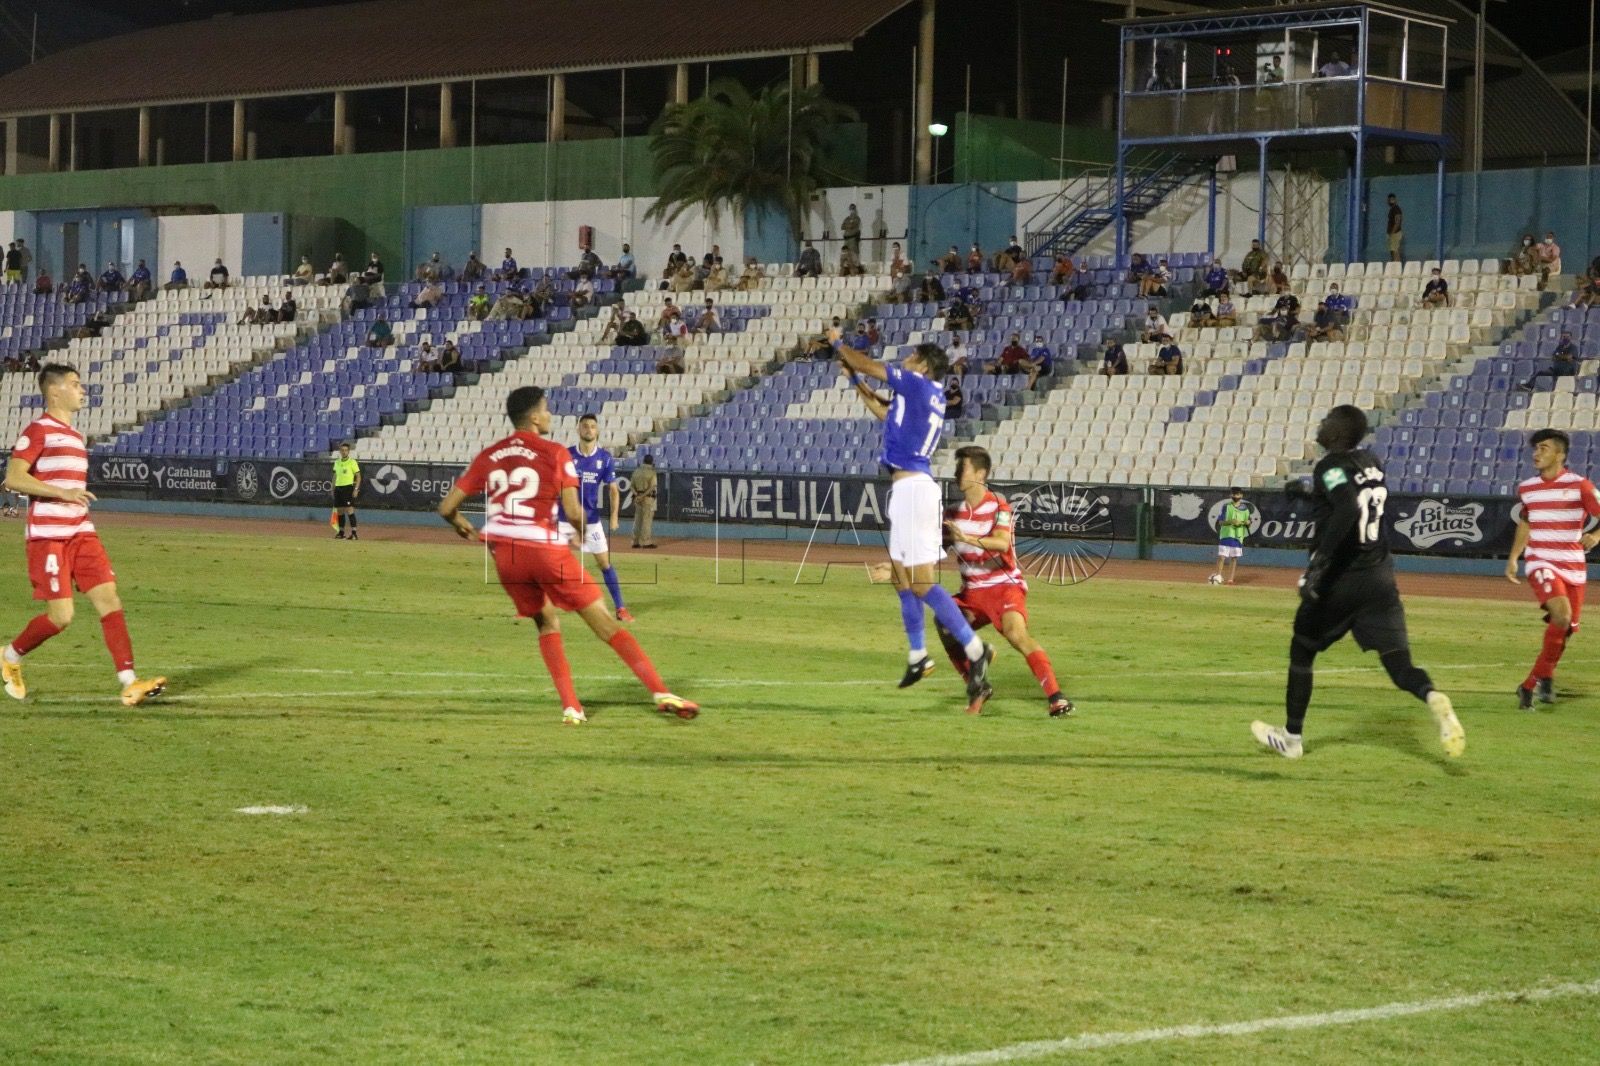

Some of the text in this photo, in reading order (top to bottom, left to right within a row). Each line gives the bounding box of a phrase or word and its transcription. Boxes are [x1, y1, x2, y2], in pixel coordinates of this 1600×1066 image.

[102, 462, 149, 480] SAITO
[167, 466, 212, 478] Catalana
[166, 478, 217, 490] Occidente
[486, 465, 541, 519] 22
[720, 478, 884, 524] MELILLA
[1421, 506, 1442, 523] Bi
[1030, 519, 1090, 533] Center
[1409, 517, 1475, 538] frutas
[45, 554, 60, 575] 4
